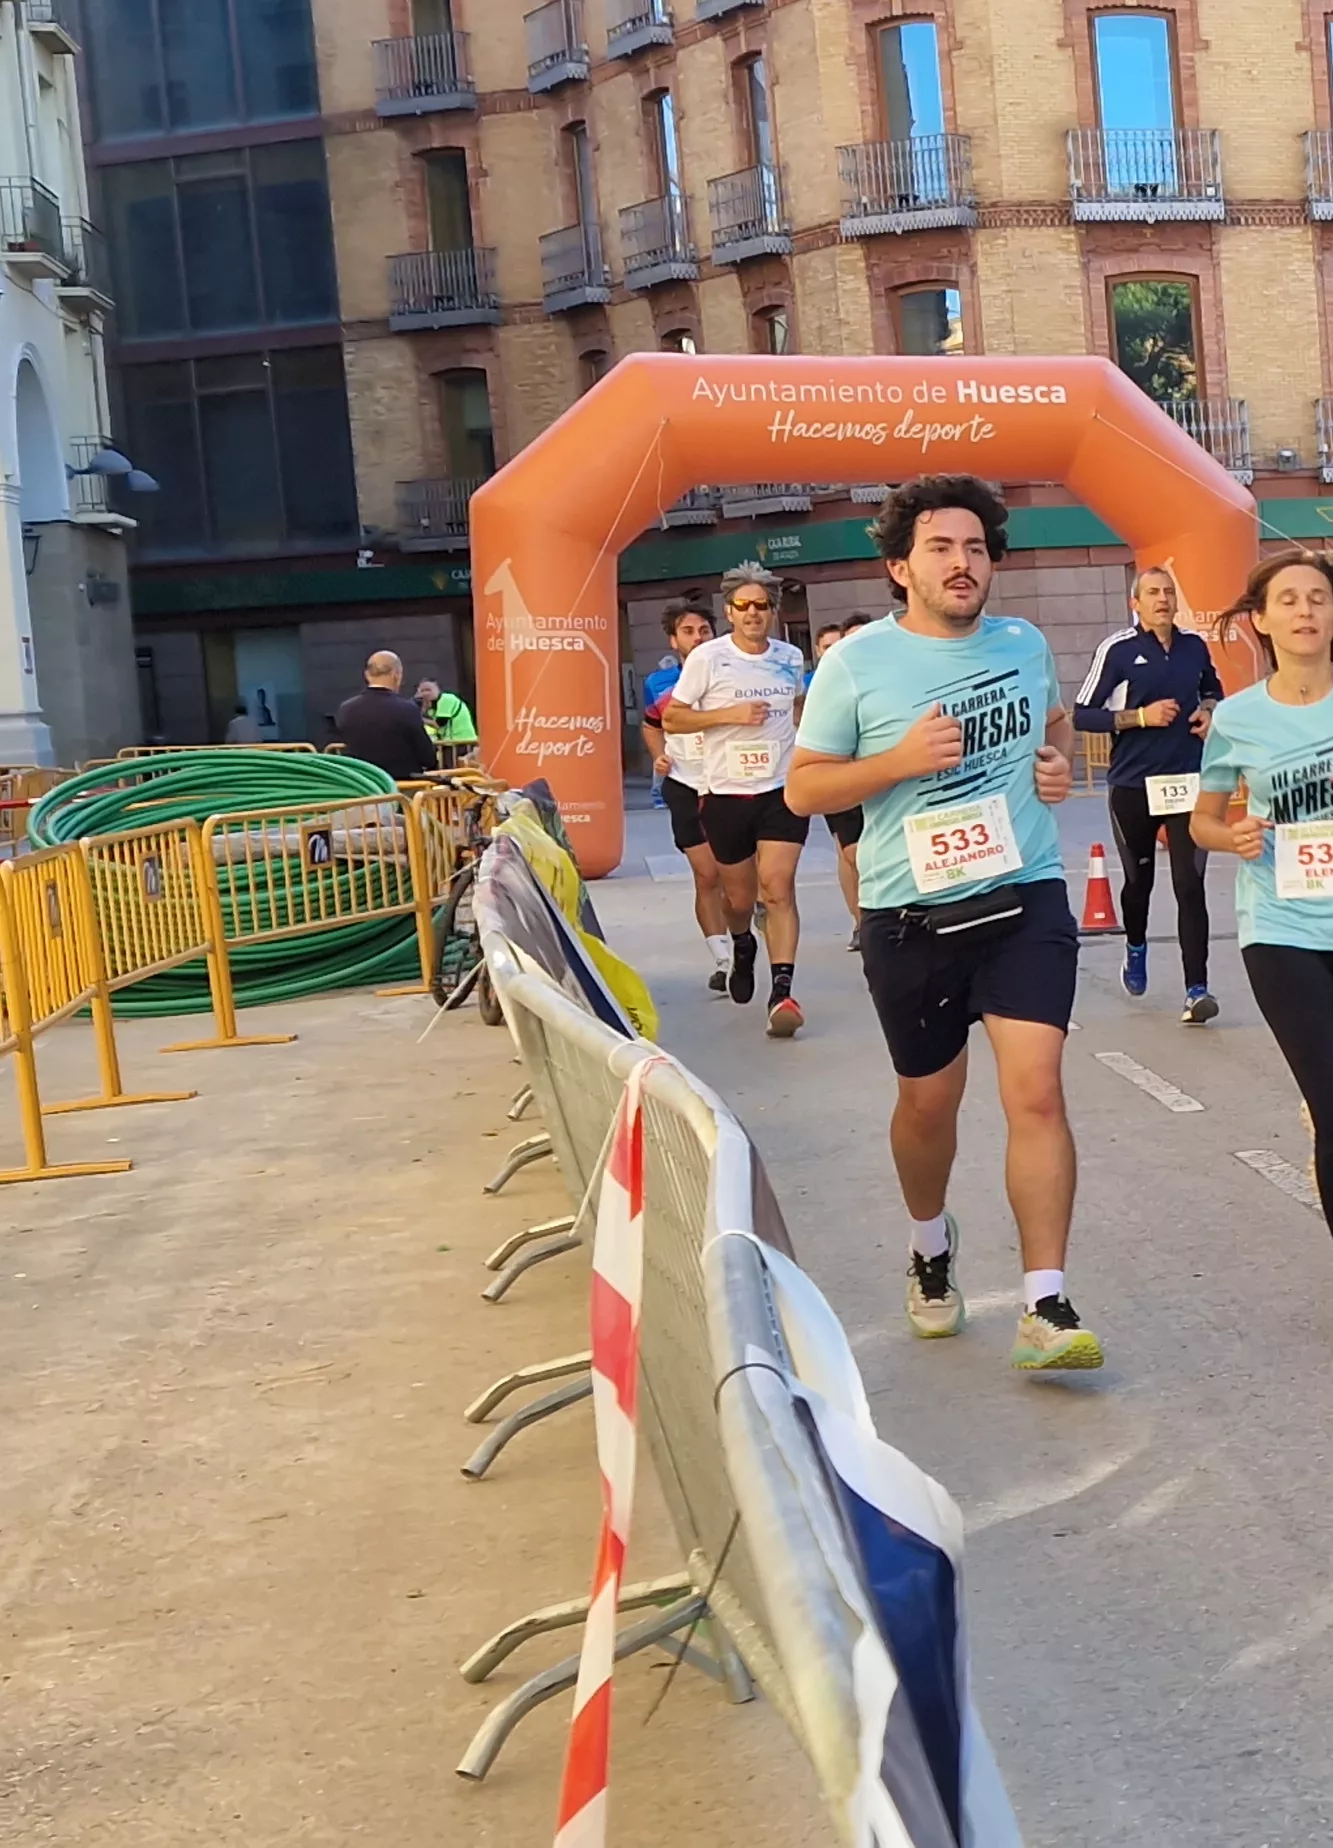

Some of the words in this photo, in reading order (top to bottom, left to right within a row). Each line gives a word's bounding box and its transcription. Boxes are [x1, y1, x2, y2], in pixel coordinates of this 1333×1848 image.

[692, 377, 903, 408] Ayuntamiento
[912, 379, 947, 404] de
[956, 379, 1067, 404] Huesca
[767, 408, 889, 445] Hacemos
[893, 408, 997, 454] deporte
[485, 611, 608, 636] Ayuntamiento
[487, 633, 505, 652] de
[509, 633, 585, 651] Huesca
[951, 686, 1008, 718] CARRERA
[514, 705, 605, 734] Hacemos
[961, 695, 1032, 759] RESAS
[515, 731, 596, 767] deporte
[739, 752, 770, 765] 336
[936, 765, 961, 782] ESIC
[964, 746, 1008, 773] HUESCA
[1160, 785, 1188, 798] 133
[1271, 769, 1290, 791] III
[930, 823, 990, 856] 533
[924, 844, 1005, 872] ALEJANDRO
